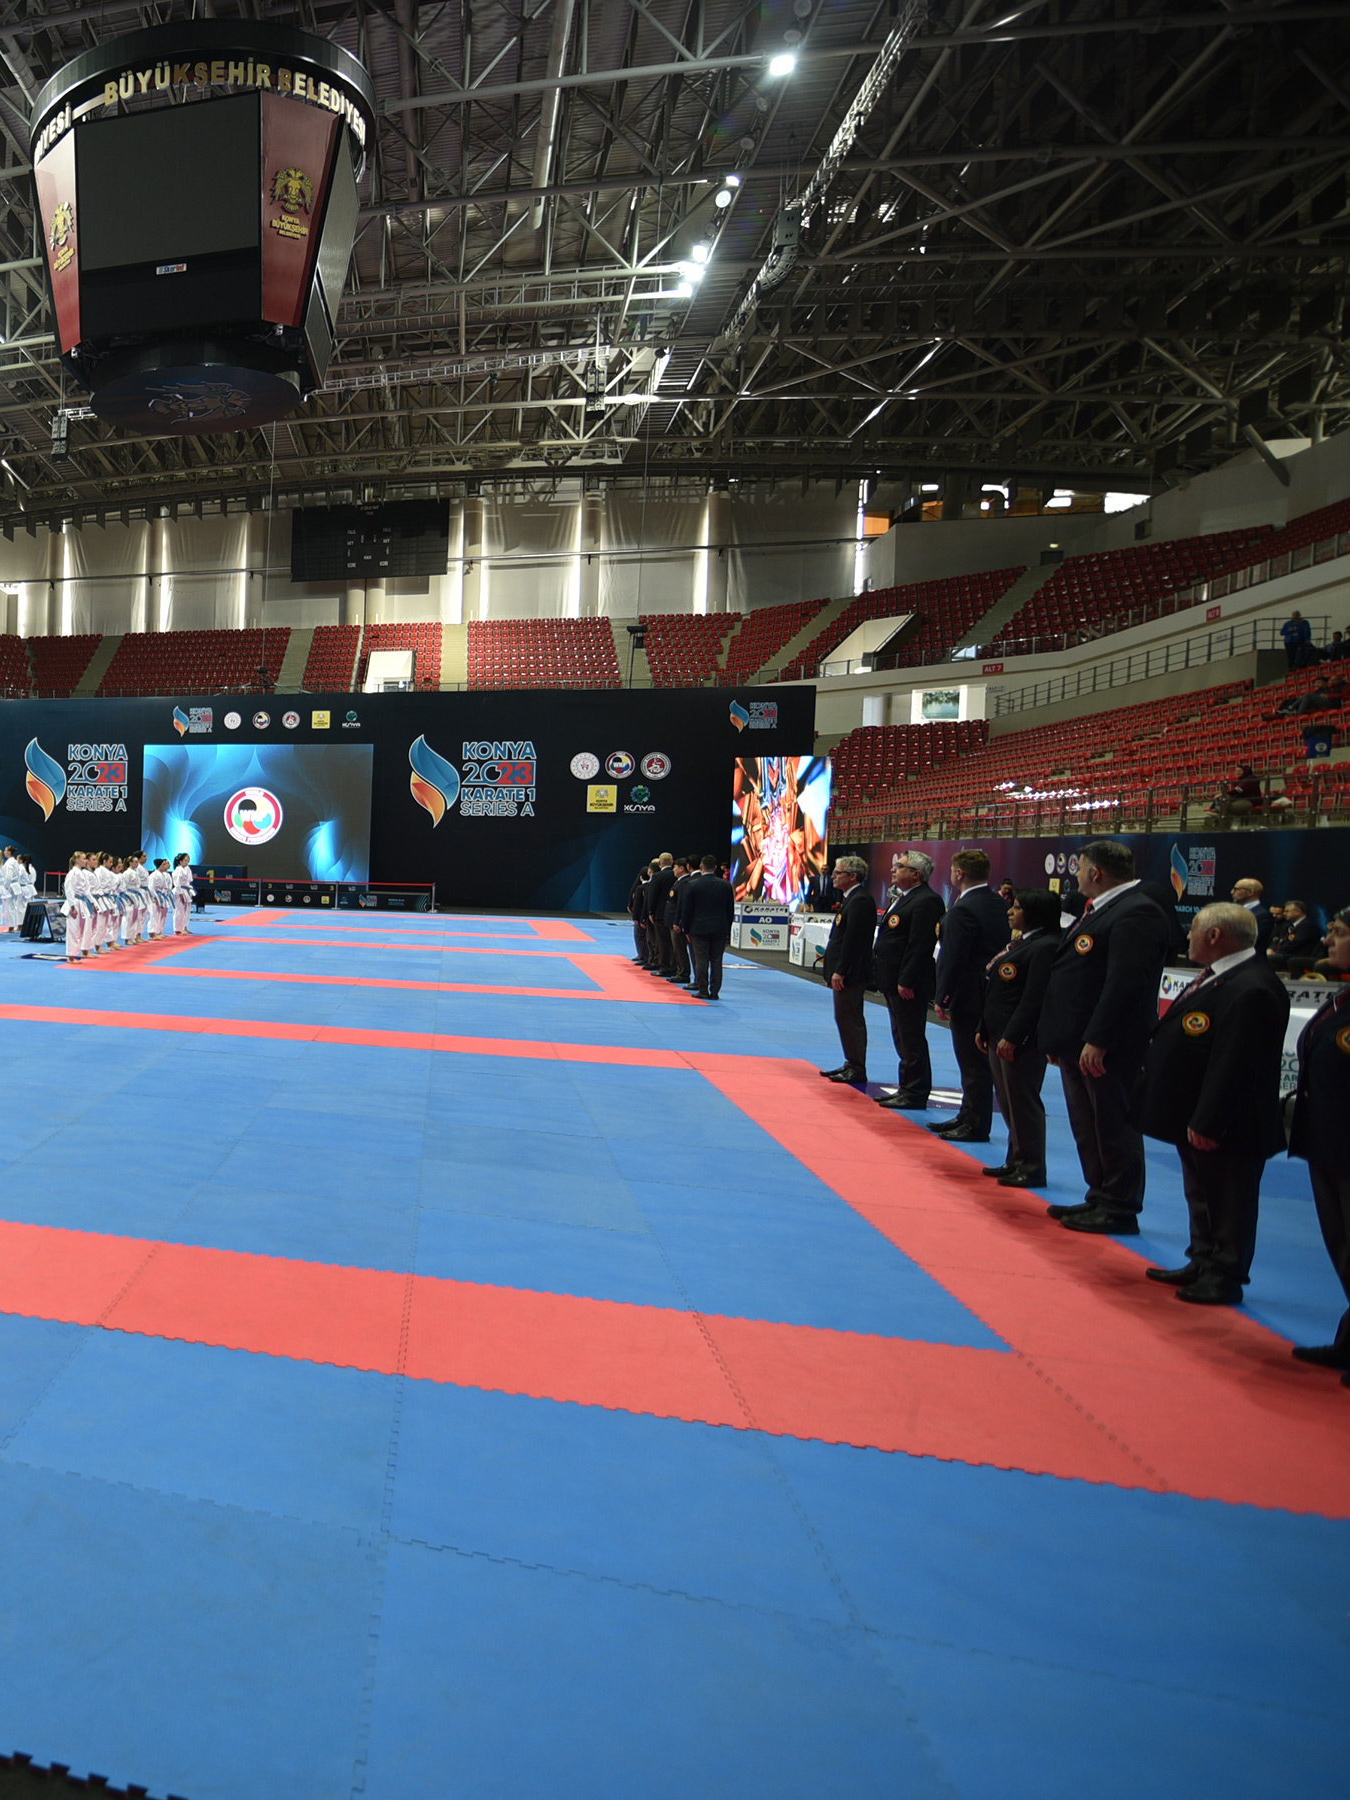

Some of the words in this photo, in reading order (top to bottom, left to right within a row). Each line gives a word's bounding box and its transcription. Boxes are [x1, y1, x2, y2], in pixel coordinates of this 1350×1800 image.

[104, 57, 271, 106] BÜYÜKŞEHİR
[68, 744, 128, 760] KONYA
[462, 741, 537, 760] KONYA
[68, 761, 127, 784] 2023
[461, 760, 536, 786] 2023
[67, 785, 119, 798] KARATE
[120, 785, 127, 798] 1
[461, 788, 525, 801] KARATE
[527, 788, 536, 802] 1
[66, 798, 113, 812] SERIES
[115, 798, 127, 812] A
[460, 802, 517, 816] SERIES
[520, 802, 535, 816] A
[1188, 860, 1216, 876] 2023
[206, 870, 214, 883] 1
